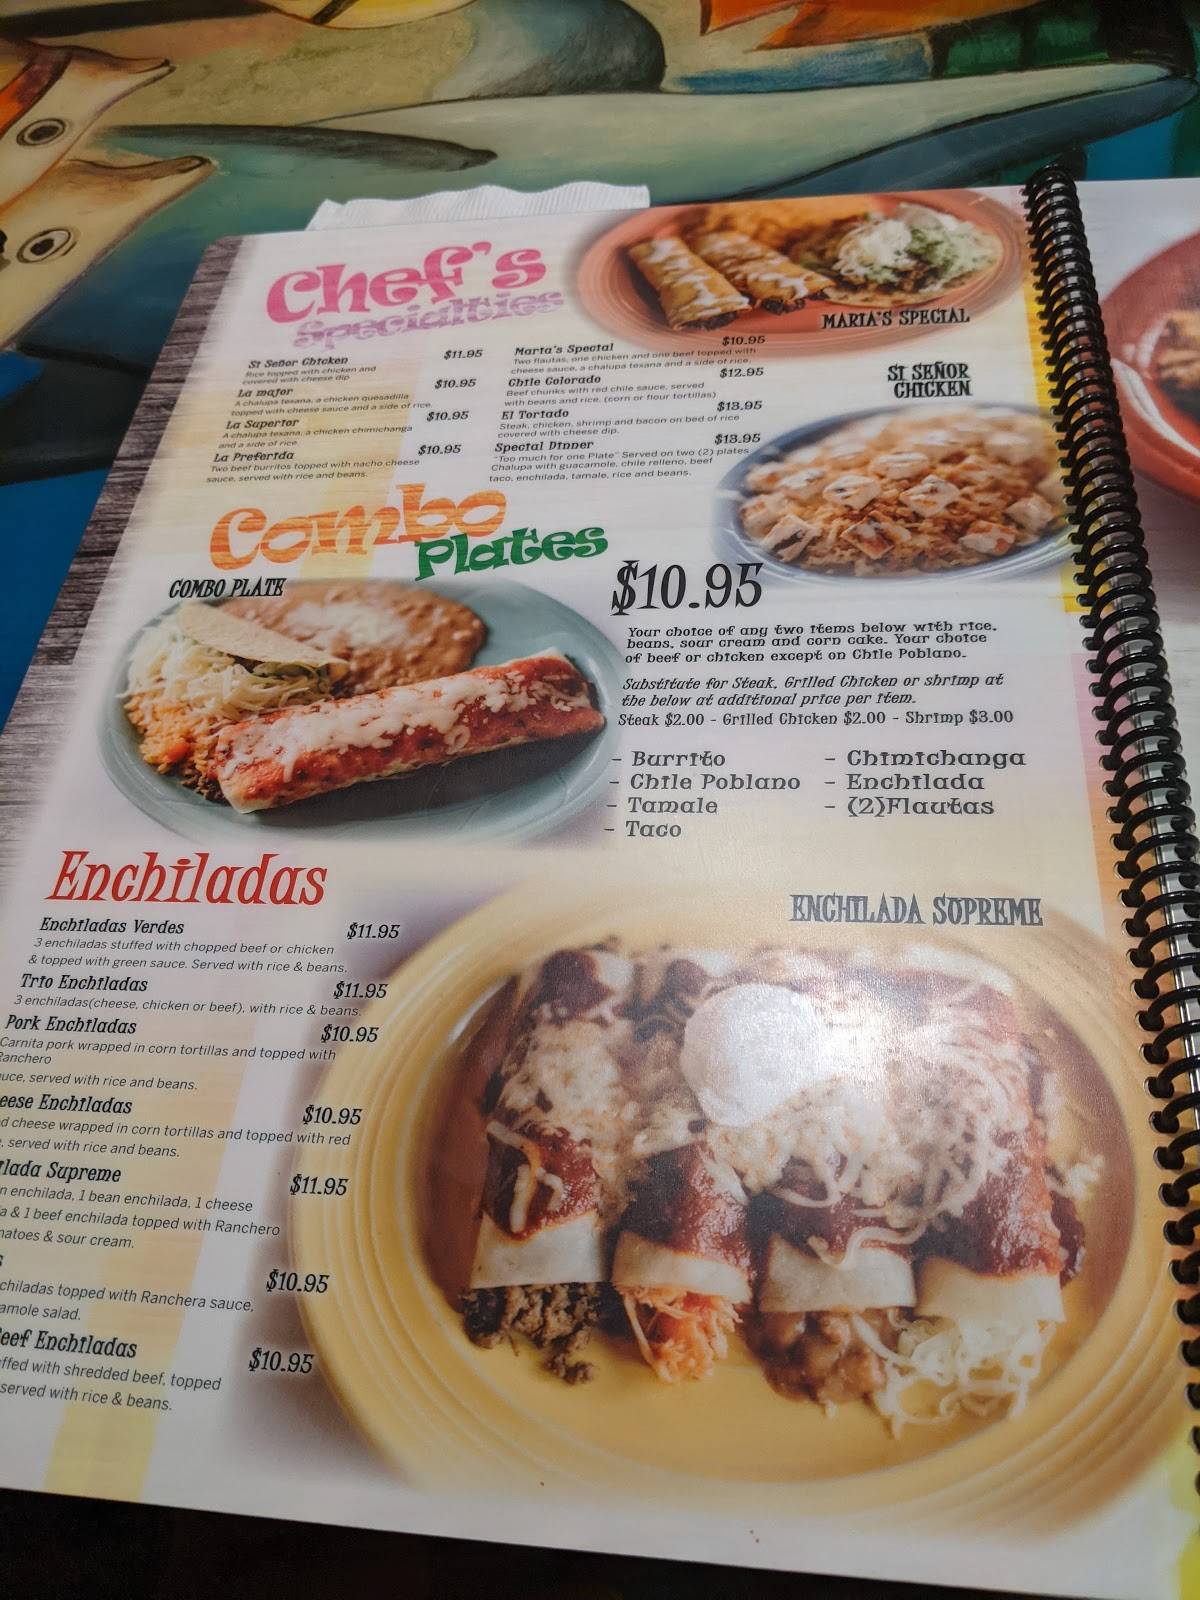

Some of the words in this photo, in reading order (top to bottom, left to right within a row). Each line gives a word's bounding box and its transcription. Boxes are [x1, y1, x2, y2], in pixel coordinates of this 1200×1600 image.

[266, 241, 546, 323] Chef's
[293, 292, 564, 349] Specialties
[822, 310, 892, 329] MARIA'S
[899, 307, 970, 325] SPECIAL
[722, 335, 766, 346] $10.95
[443, 349, 483, 360] $11.95
[514, 345, 563, 356] Maria's
[567, 343, 614, 354] Special
[302, 356, 348, 366] Chicken
[720, 367, 764, 378] $12.95
[888, 363, 908, 382] SI
[912, 361, 970, 380] SEÑOR
[434, 378, 477, 389] $10.95
[508, 377, 541, 387] Chile
[545, 375, 601, 386] Colorado
[894, 380, 973, 398] CHICKEN
[238, 389, 252, 398] La
[717, 400, 762, 412] $13.95
[427, 411, 469, 422] $10.95
[501, 410, 514, 420] El
[226, 421, 241, 430] La
[244, 419, 300, 430] Superior
[497, 430, 537, 439] covered
[563, 429, 598, 437] cheese
[601, 428, 619, 436] dip.
[714, 433, 761, 445] $13.95
[418, 444, 462, 456] $10.95
[494, 441, 543, 454] Special
[548, 441, 594, 451] Dinner
[213, 453, 229, 462] La
[232, 451, 295, 461] Preferida
[491, 464, 532, 472] Chalupa
[559, 461, 618, 470] guacamole,
[621, 459, 646, 467] chile
[690, 457, 713, 465] beef
[516, 473, 568, 481] enchilada,
[571, 472, 609, 480] tamale,
[635, 470, 654, 478] and
[657, 469, 692, 477] beans.
[210, 483, 506, 571] Combo
[414, 527, 608, 582] Plates
[169, 578, 228, 598] COMBO
[229, 577, 287, 597] PLATE
[610, 560, 764, 616] $10.95
[628, 627, 661, 637] Your
[666, 627, 713, 637] choice
[718, 626, 735, 636] of
[740, 627, 768, 637] any
[774, 624, 804, 634] two
[810, 623, 855, 634] items
[861, 622, 906, 633] below
[913, 621, 952, 631] with
[680, 639, 713, 648] sour
[719, 638, 765, 647] cream
[771, 636, 801, 646] and
[807, 637, 841, 646] corn
[847, 634, 888, 645] cake.
[894, 633, 929, 644] Your
[936, 633, 987, 643] choice
[625, 653, 642, 663] of
[647, 653, 680, 663] beef
[685, 654, 701, 662] or
[706, 652, 765, 662] chicken
[770, 650, 823, 663] except
[828, 651, 846, 660] on
[853, 649, 893, 659] Chile
[899, 648, 967, 659] Poblano.
[623, 678, 701, 690] Substitute
[706, 677, 728, 689] for
[784, 676, 836, 688] Grilled
[840, 675, 898, 687] Chicken
[903, 677, 920, 686] or
[924, 674, 980, 688] shrimp
[985, 673, 1004, 686] at
[622, 694, 646, 706] the
[649, 695, 692, 706] below
[696, 694, 714, 706] at
[717, 693, 797, 705] additional
[800, 694, 841, 707] price
[844, 694, 872, 707] per
[876, 691, 917, 704] item.
[618, 713, 660, 726] Steak
[664, 712, 704, 727] $2.00
[723, 713, 774, 725] Grilled
[780, 712, 837, 725] Chicken
[843, 711, 886, 725] $2.00
[906, 711, 963, 726] Shrimp
[969, 709, 1013, 724] $3.00
[632, 751, 726, 767] Burrito
[847, 750, 1026, 770] Chimichanga
[630, 774, 692, 790] Chile
[701, 774, 800, 790] Poblano
[846, 774, 985, 790] Enchilada
[628, 797, 718, 814] Tamale
[847, 796, 995, 817] (2)Flautas
[626, 821, 682, 837] Taco
[44, 850, 328, 906] Enchiladas
[788, 892, 927, 925] ENCHILADA
[40, 917, 127, 933] Enchiladas
[133, 919, 185, 934] Verdes
[347, 922, 400, 940] $11.95
[33, 938, 42, 948] 3
[44, 938, 107, 949] enchiladas
[110, 940, 153, 950] stuffed
[156, 941, 181, 951] with
[184, 941, 237, 954] chopped
[239, 943, 267, 954] beef
[269, 945, 283, 954] or
[286, 944, 334, 955] chicken
[28, 955, 37, 964] &
[41, 955, 83, 967] topped
[85, 956, 110, 966] with
[112, 958, 146, 969] green
[149, 960, 188, 969] sauce.
[191, 959, 234, 970] Served
[238, 960, 263, 971] with
[266, 962, 290, 972] rice
[293, 961, 303, 972] &
[306, 962, 348, 974] beans.
[20, 973, 53, 988] Trio
[57, 974, 148, 992] Enchiladas
[333, 981, 388, 999] $11.95
[14, 995, 23, 1005] 3
[142, 1000, 189, 1012] chicken
[192, 1003, 206, 1012] or
[250, 1003, 276, 1014] with
[279, 1004, 303, 1015] rice
[306, 1005, 316, 1015] &
[320, 1005, 362, 1016] beans.
[5, 1014, 41, 1031] Pork
[45, 1015, 137, 1034] Enchiladas
[321, 1024, 379, 1043] $10.95
[0, 1037, 43, 1049] Carnita
[46, 1040, 74, 1051] pork
[78, 1040, 130, 1053] wrapped
[133, 1041, 144, 1052] in
[148, 1044, 177, 1054] corn
[180, 1043, 228, 1056] tortillas
[232, 1047, 256, 1057] and
[259, 1047, 305, 1061] topped
[309, 1049, 336, 1060] with
[38, 1094, 133, 1114] Enchiladas
[303, 1104, 362, 1125] $10.95
[46, 1161, 122, 1183] Supreme
[290, 1174, 349, 1196] $11.95
[266, 1269, 330, 1293] $10.95
[0, 1328, 33, 1347] eef
[34, 1330, 137, 1358] Enchiladas
[248, 1347, 314, 1374] $10.95
[32, 1361, 61, 1376] with
[63, 1365, 130, 1382] shredded
[170, 1373, 222, 1391] topped
[0, 1382, 46, 1398] served
[50, 1387, 78, 1401] with
[82, 1390, 109, 1404] rice
[111, 1392, 123, 1406] &
[126, 1393, 172, 1411] beans.
